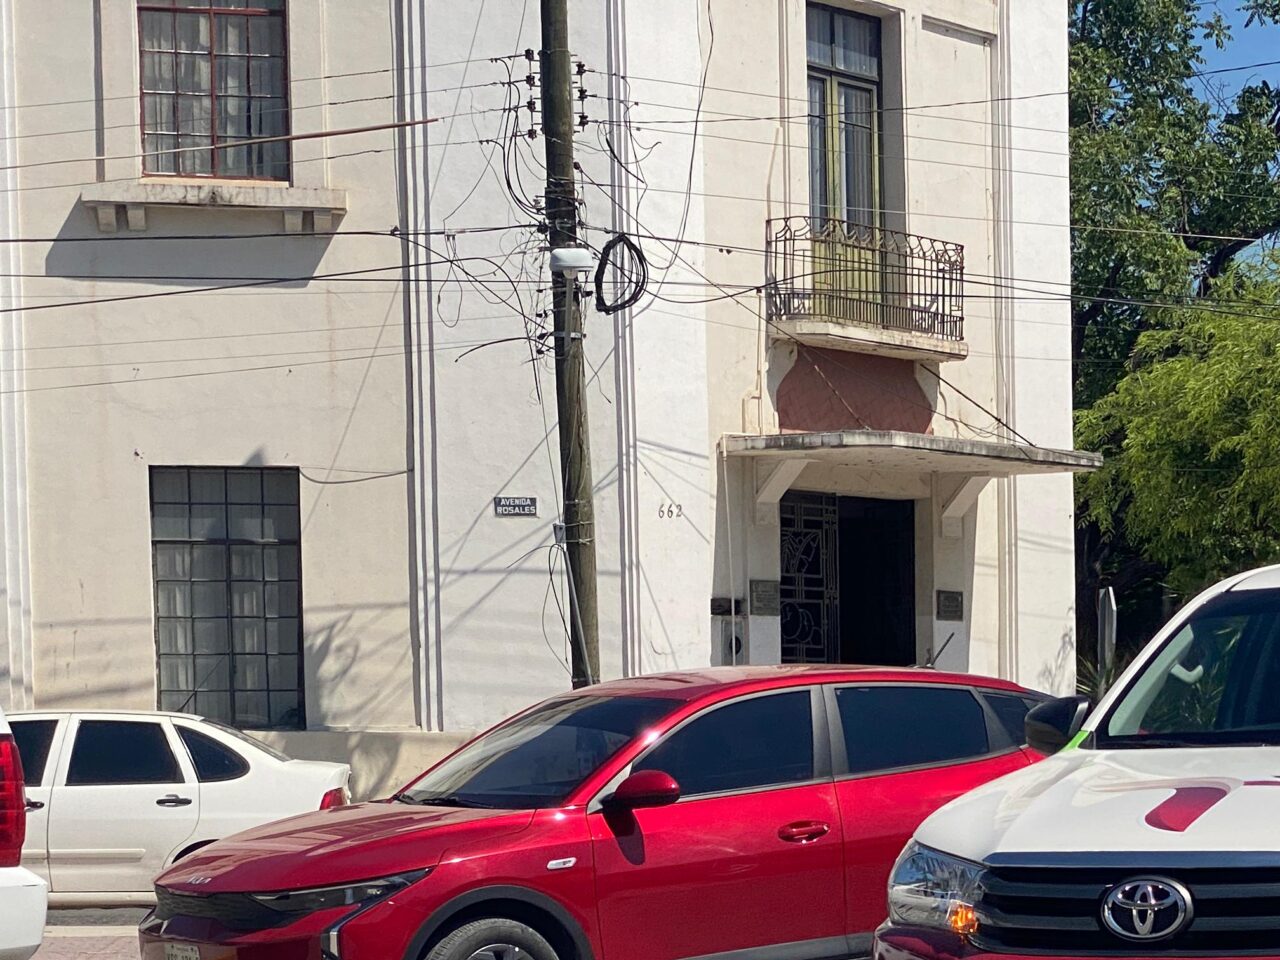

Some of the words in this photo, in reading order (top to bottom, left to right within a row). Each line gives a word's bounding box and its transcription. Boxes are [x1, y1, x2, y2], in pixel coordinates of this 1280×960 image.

[500, 498, 532, 506] AVENIDA
[496, 506, 536, 514] ROSALES
[658, 503, 682, 519] 662
